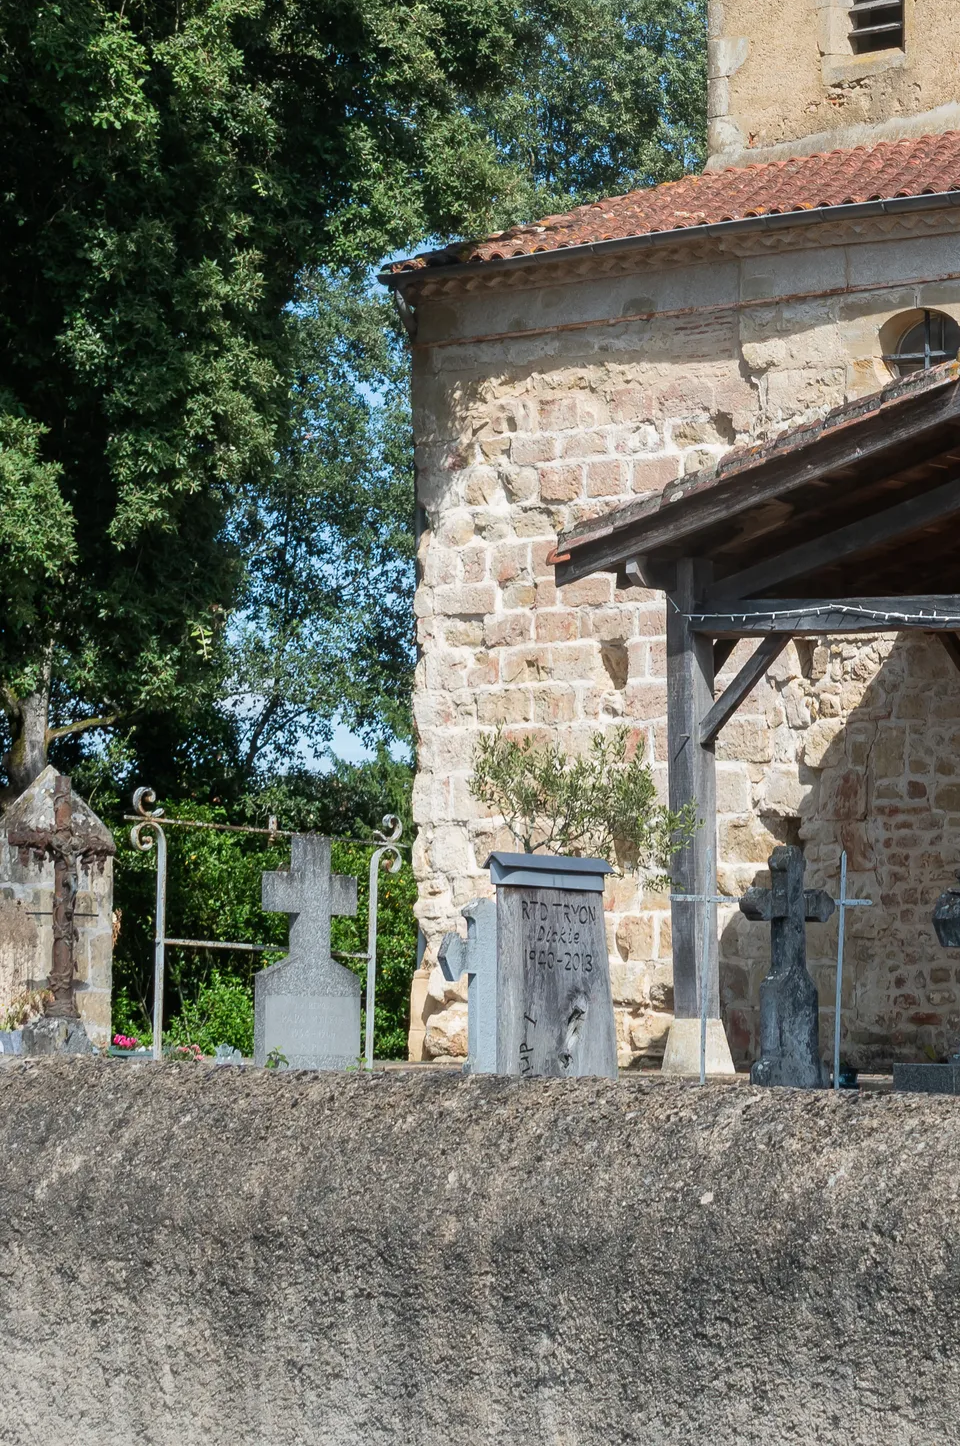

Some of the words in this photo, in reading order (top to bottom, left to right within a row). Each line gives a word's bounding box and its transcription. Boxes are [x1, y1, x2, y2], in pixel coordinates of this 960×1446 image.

[521, 900, 548, 922] RTD
[552, 903, 597, 925] TRYON
[537, 925, 580, 945] Dickie
[524, 948, 594, 973] 1940-2013
